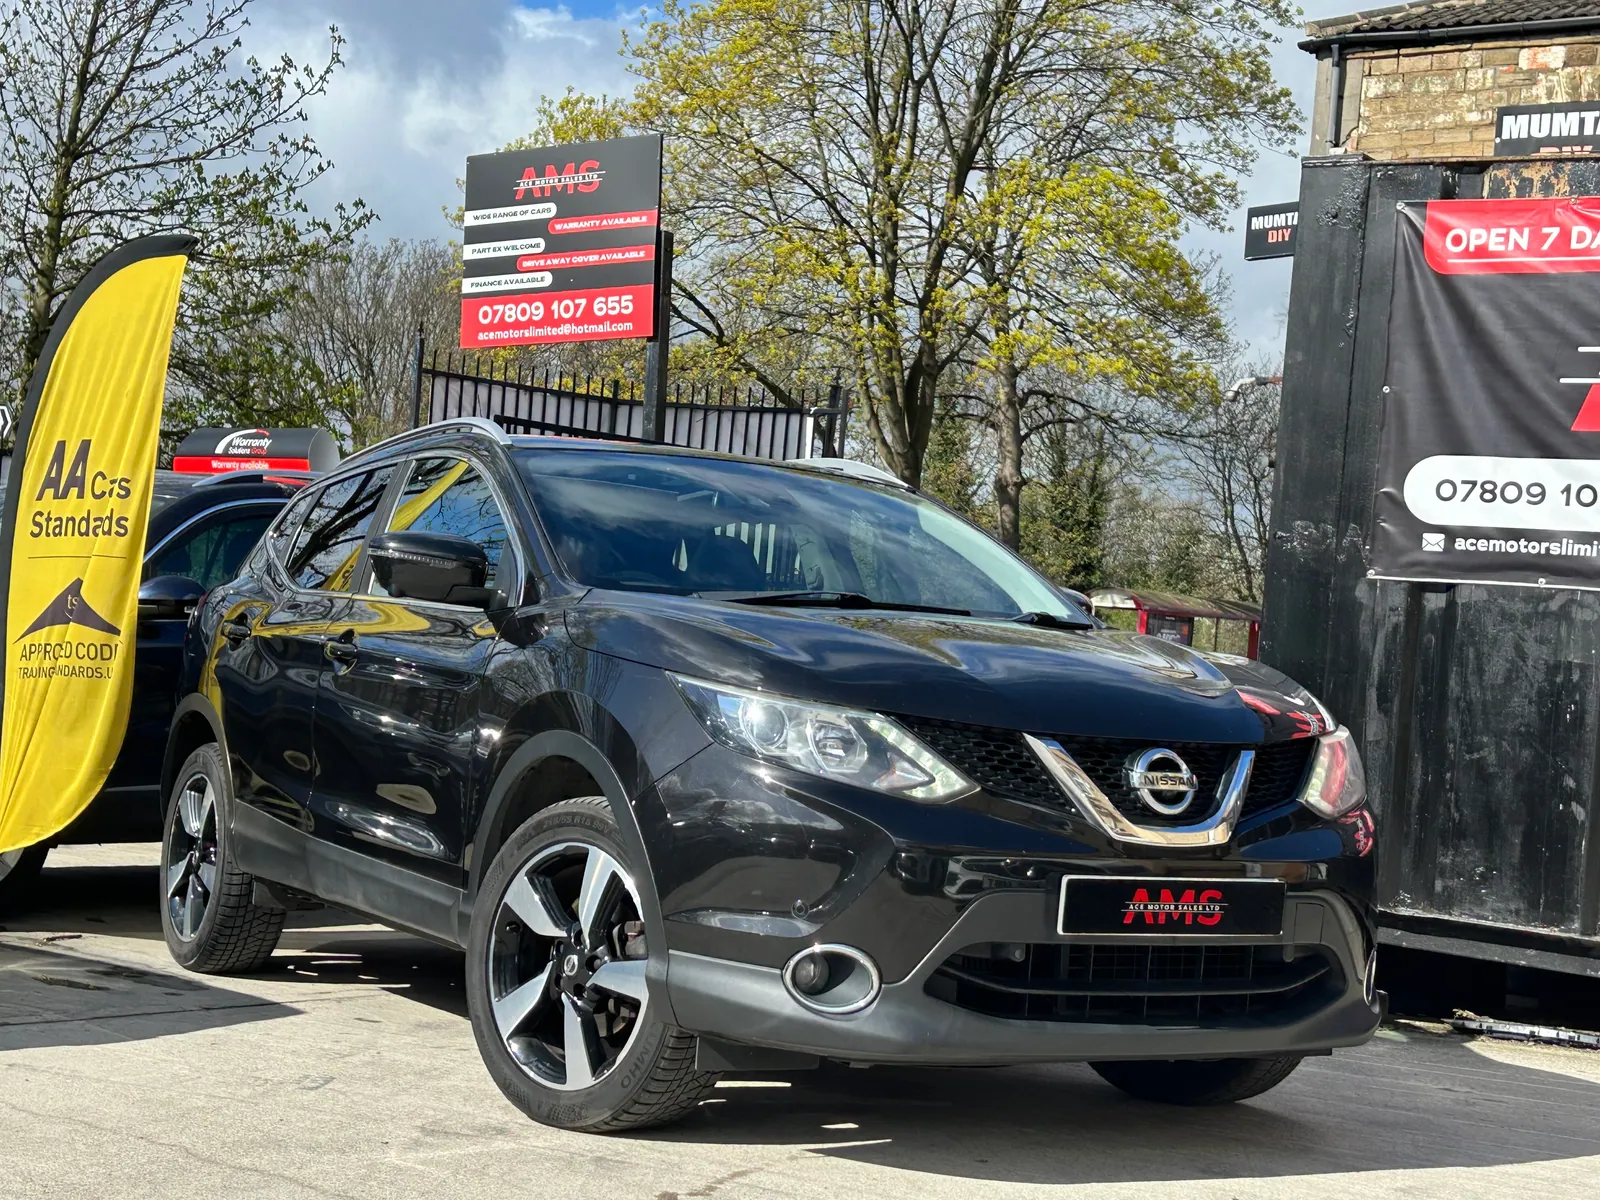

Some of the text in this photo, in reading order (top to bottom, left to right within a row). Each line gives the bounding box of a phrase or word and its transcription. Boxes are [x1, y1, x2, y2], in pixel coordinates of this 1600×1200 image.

[1501, 110, 1600, 140] MUMT
[516, 159, 600, 200] AMS
[534, 178, 559, 186] MOTOR
[561, 175, 583, 183] SALES
[584, 173, 598, 181] LTD
[472, 213, 491, 221] WIDE
[492, 210, 518, 219] RANGE
[530, 207, 552, 215] CARS
[554, 215, 648, 231] WARRANTY AVAILABLE
[1267, 228, 1292, 243] DIY
[1445, 226, 1530, 253] OPEN
[1540, 226, 1561, 251] 7
[471, 247, 491, 255] PART
[503, 242, 541, 252] WELCOME
[522, 250, 646, 268] DRIVE AWAY COVER AVAILABLE
[470, 276, 546, 288] FINANCE AVAILABLE
[478, 295, 634, 325] 07809 107 655
[477, 320, 634, 341] acemotorslimited@hotmail.com
[231, 437, 273, 450] Warranty
[35, 438, 92, 501] AA
[211, 460, 270, 471] Warranty available
[1435, 478, 1547, 506] 07809
[1454, 537, 1600, 557] acemotorslimi
[1143, 775, 1196, 786] NISSAN
[1123, 888, 1223, 926] AMS
[1147, 903, 1175, 911] MOTOR
